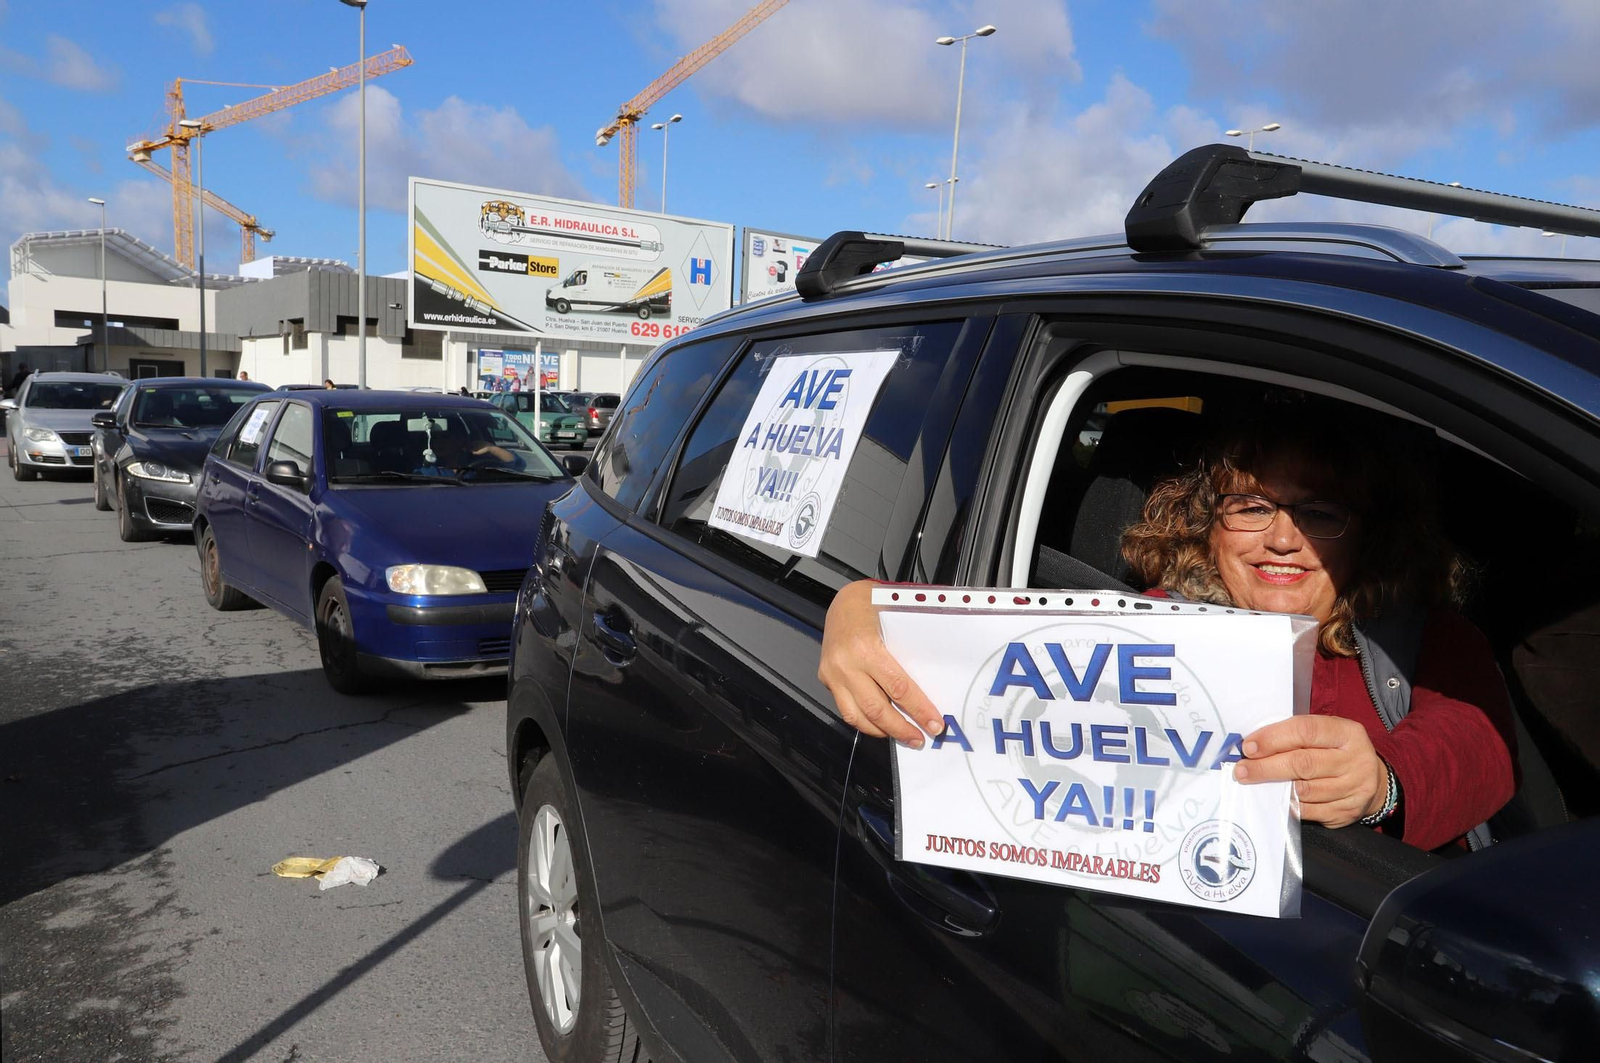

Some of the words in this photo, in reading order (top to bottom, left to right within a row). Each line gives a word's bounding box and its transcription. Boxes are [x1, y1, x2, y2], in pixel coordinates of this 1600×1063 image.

[530, 215, 551, 227] E.R.
[554, 218, 618, 236] HIDRAULICA
[621, 227, 639, 239] S.L.
[530, 237, 551, 246] SERVICIO
[489, 256, 528, 272] Parker
[530, 261, 557, 274] Store
[423, 312, 497, 325] www.erhidraulica.es
[631, 322, 660, 338] 629
[779, 369, 853, 410] AVE
[744, 422, 761, 449] A
[761, 423, 845, 460] HUELVA
[755, 466, 799, 502] YA!!!
[715, 506, 734, 522] JUNTOS
[749, 514, 784, 536] IMPARABLES
[988, 642, 1177, 706] AVE
[931, 714, 974, 752] A
[992, 718, 1245, 770] HUELVA
[1017, 778, 1156, 833] YA!!!
[925, 834, 986, 859] JUNTOS
[989, 842, 1048, 867] SOMOS
[1051, 850, 1161, 884] IMPARABLES
[1184, 869, 1204, 894] AVE
